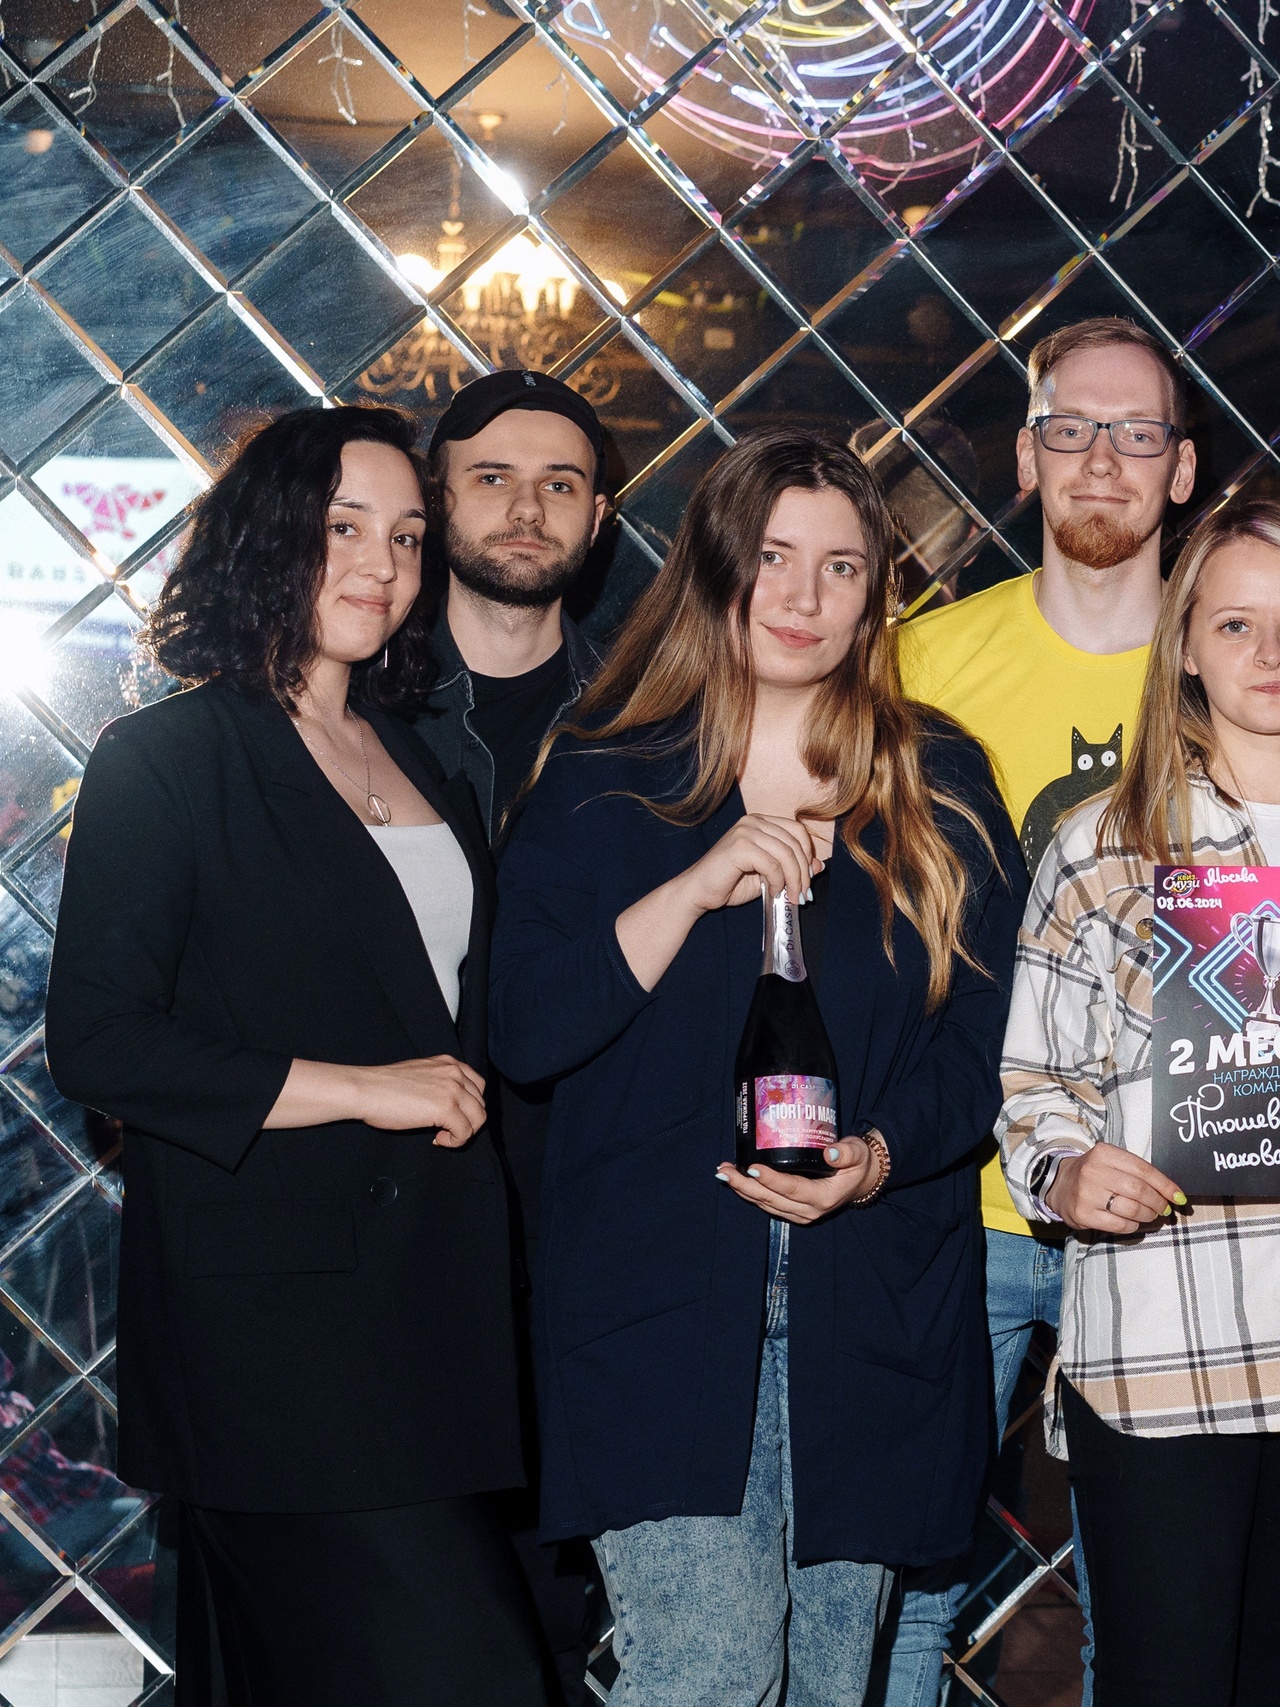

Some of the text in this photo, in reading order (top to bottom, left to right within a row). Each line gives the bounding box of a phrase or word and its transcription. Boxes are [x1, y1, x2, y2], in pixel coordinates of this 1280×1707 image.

[1163, 876, 1200, 891] Смузи
[1204, 867, 1258, 887] Москва
[1156, 896, 1223, 911] 08.06.2024
[1168, 1038, 1195, 1075] 2
[769, 1104, 801, 1120] FIORI
[805, 1104, 816, 1120] DI
